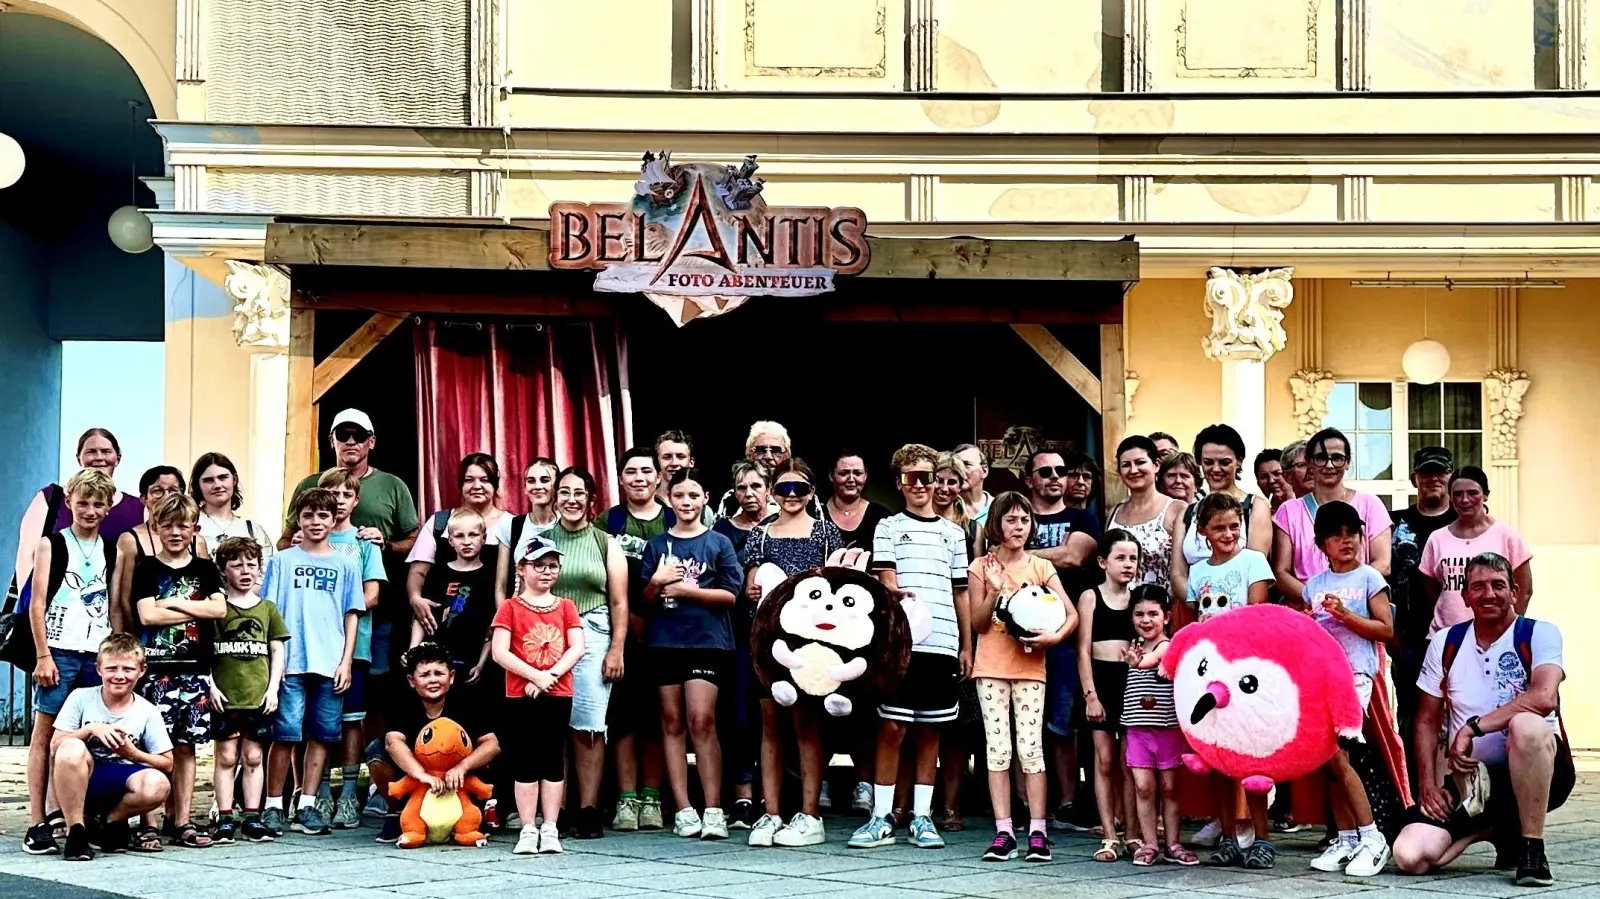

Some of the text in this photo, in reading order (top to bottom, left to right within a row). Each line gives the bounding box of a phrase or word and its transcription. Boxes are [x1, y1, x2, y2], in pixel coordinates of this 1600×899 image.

[558, 173, 859, 285] BELANTIS
[668, 272, 828, 290] FOTO ABENTEUER
[294, 567, 338, 580] GOOD
[293, 578, 335, 592] LIFE
